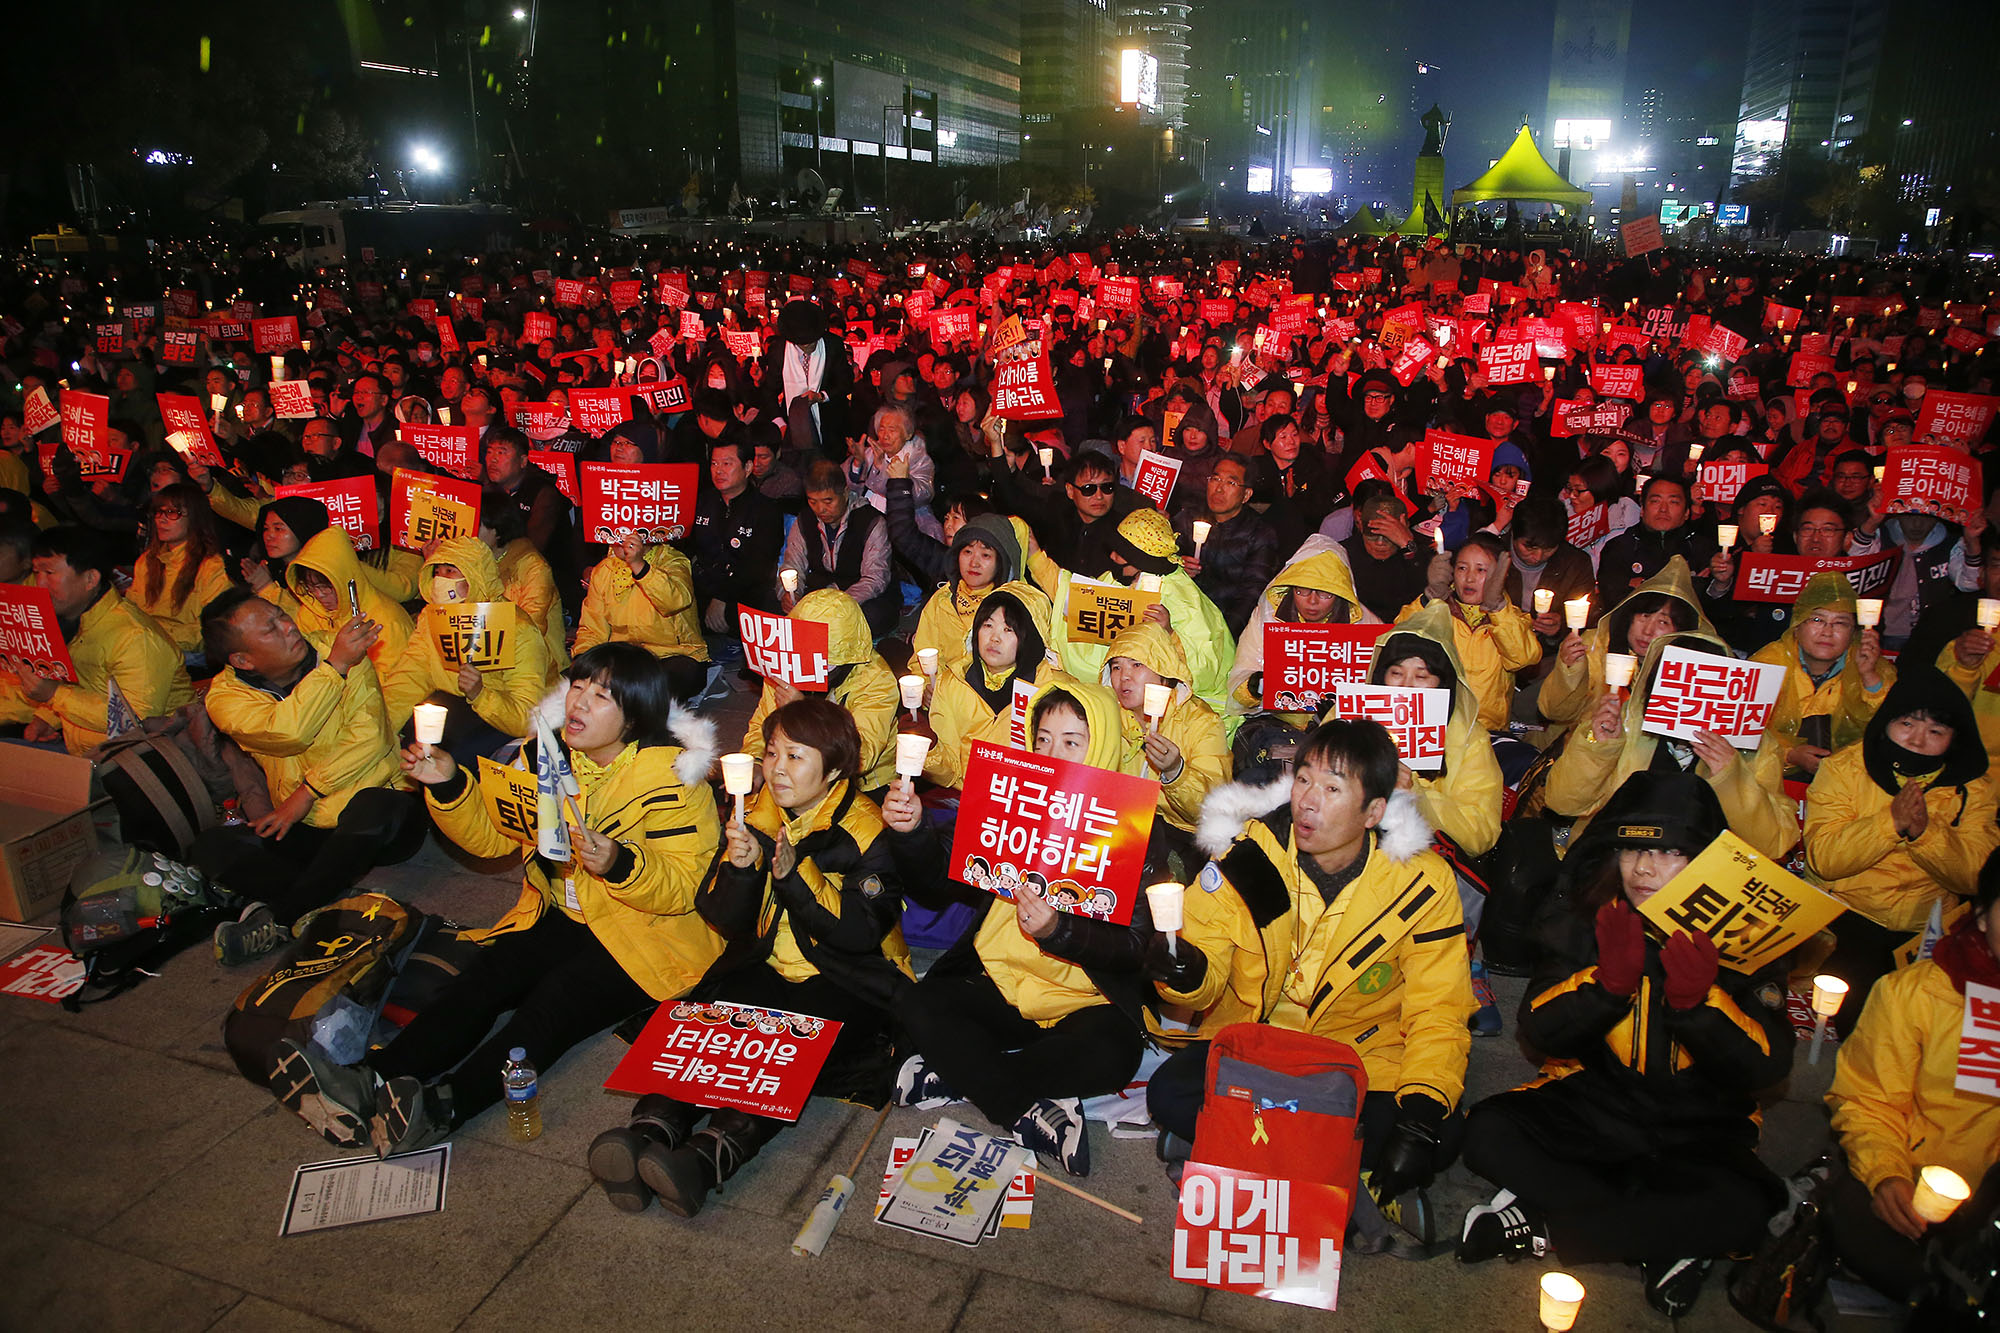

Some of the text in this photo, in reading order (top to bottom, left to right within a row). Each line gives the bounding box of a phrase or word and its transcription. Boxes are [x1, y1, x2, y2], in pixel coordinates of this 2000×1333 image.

[557, 282, 583, 293] 박근혜
[561, 293, 577, 302] 퇴진
[1104, 285, 1132, 296] 박근혜를
[123, 306, 154, 318] 박근혜
[1647, 308, 1673, 322] 이게
[96, 323, 123, 336] 박근혜
[164, 332, 197, 344] 박근혜
[220, 324, 244, 338] 퇴진!
[97, 335, 123, 353] 퇴진
[162, 344, 196, 362] 퇴진
[1481, 342, 1533, 364] 박근혜
[998, 362, 1039, 387] 몰아내자
[1489, 363, 1526, 382] 퇴진
[1595, 367, 1639, 380] 박근혜
[654, 386, 684, 408] 퇴진!
[996, 386, 1045, 410] 박근혜를
[1601, 380, 1633, 395] 퇴진
[63, 405, 96, 427] 근혜는
[578, 398, 621, 412] 박근혜를
[580, 413, 623, 427] 몰아내자
[1566, 412, 1618, 428] 박근혜 퇴진
[63, 425, 96, 448] 하라
[414, 434, 467, 451] 박근혜를
[1432, 442, 1480, 465] 박근혜를
[1142, 472, 1168, 490] 퇴진
[1150, 466, 1168, 476] 박근혜
[1704, 465, 1746, 483] 이게
[1900, 457, 1971, 485] 박근혜를
[600, 479, 681, 501] 박근혜는
[1140, 483, 1164, 504] 구속
[1701, 483, 1741, 502] 나라
[1896, 477, 1969, 506] 몰아내자
[432, 505, 457, 523] 박근혜
[600, 503, 680, 524] 하야하라
[1568, 504, 1604, 534] 근혜
[1748, 566, 1814, 597] 박근
[0, 602, 45, 630] 근혜를
[1096, 596, 1133, 614] 박근혜
[449, 615, 486, 630] 박근혜
[739, 612, 792, 651] 이게
[439, 630, 505, 666] 퇴진!
[1284, 640, 1374, 664] 박근혜는
[745, 645, 828, 684] 나라냐
[1660, 661, 1760, 702] 박근혜
[1337, 693, 1424, 725] 박근혜
[1646, 694, 1772, 736] 즉각퇴진
[1398, 725, 1446, 759] 퇴진
[976, 747, 1055, 774] 나눔문화 www.nanum.com
[509, 781, 538, 806] 박근
[989, 773, 1119, 838] 박근혜는
[979, 816, 1112, 882] 하야하라
[1741, 876, 1801, 922] 박근혜
[1664, 883, 1795, 965] 퇴진!
[666, 1023, 797, 1065] 하야하라
[652, 1052, 781, 1096] 박근혜는
[1182, 1175, 1291, 1234] 이게
[1173, 1229, 1341, 1292] 나라냐
